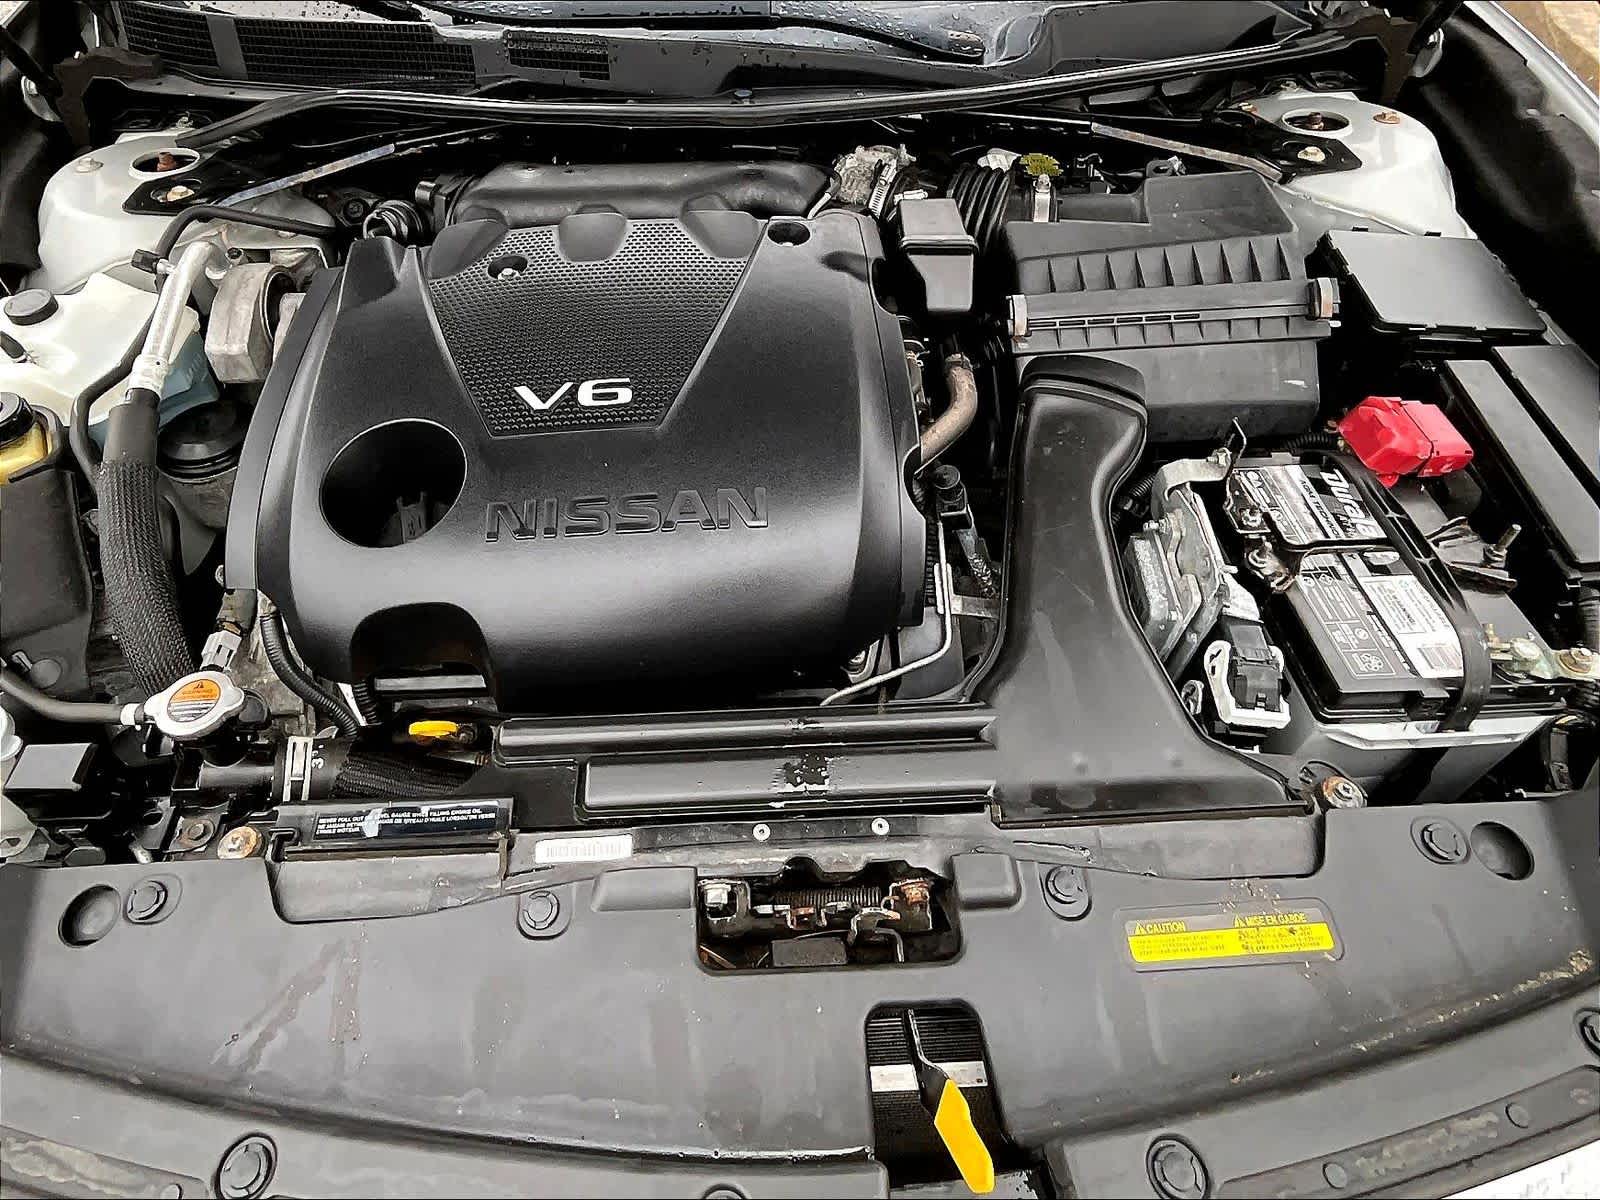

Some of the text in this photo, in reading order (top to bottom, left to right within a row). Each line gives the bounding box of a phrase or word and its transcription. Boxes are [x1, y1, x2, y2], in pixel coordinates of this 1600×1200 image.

[514, 377, 633, 411] V6
[486, 487, 768, 542] NISSAN
[1147, 921, 1186, 934] CAUTION
[1246, 912, 1307, 927] MISE EN GARDE
